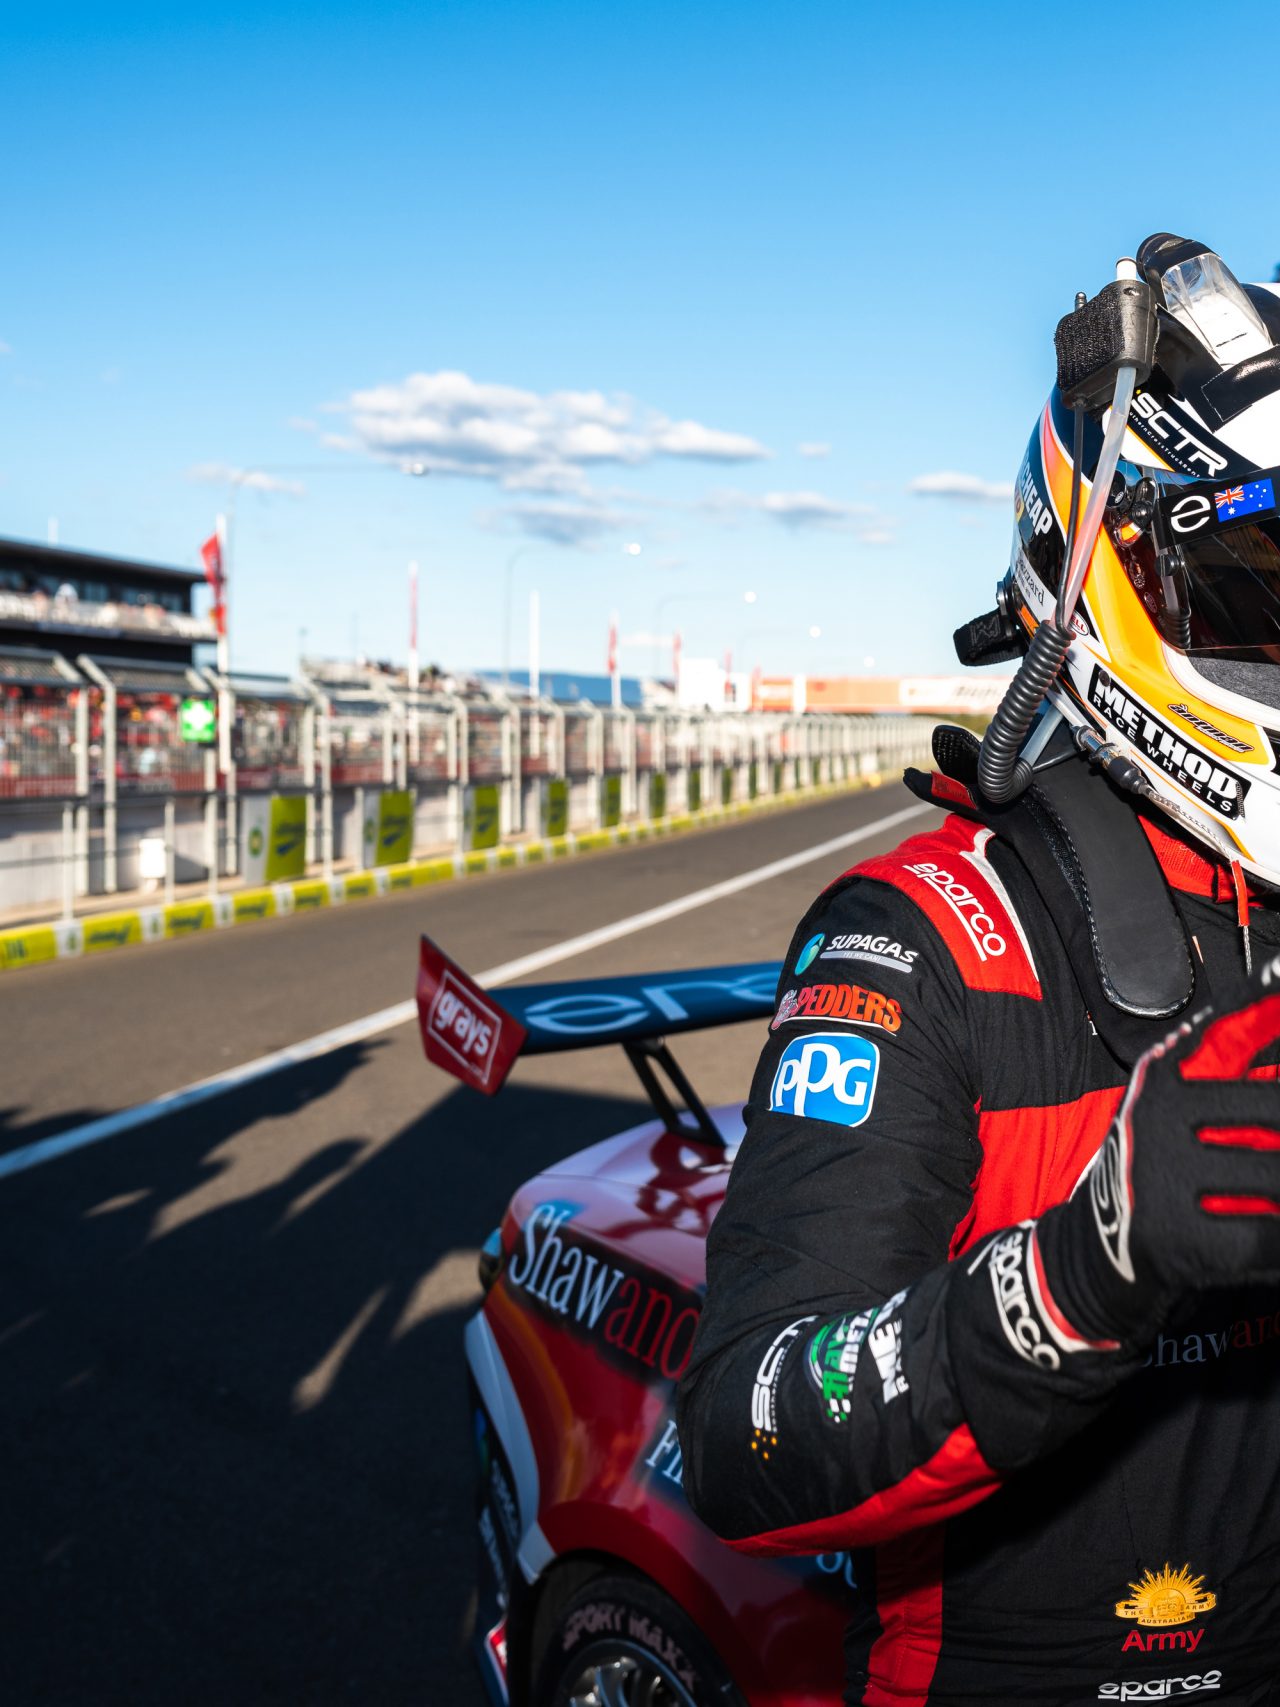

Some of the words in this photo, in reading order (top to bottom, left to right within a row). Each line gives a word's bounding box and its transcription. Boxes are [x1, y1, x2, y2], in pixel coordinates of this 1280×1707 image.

[1131, 392, 1228, 477] SCTR
[1093, 694, 1138, 743] RACE
[1146, 742, 1233, 813] WHEELS
[1095, 670, 1239, 800] METHOD
[902, 862, 1007, 963] sparco
[826, 934, 919, 963] SUPAGAS
[434, 990, 493, 1055] grays
[796, 983, 902, 1032] PEDDERS
[774, 1043, 872, 1117] PPG
[1121, 1628, 1206, 1653] Army
[1097, 1669, 1222, 1702] sparco
